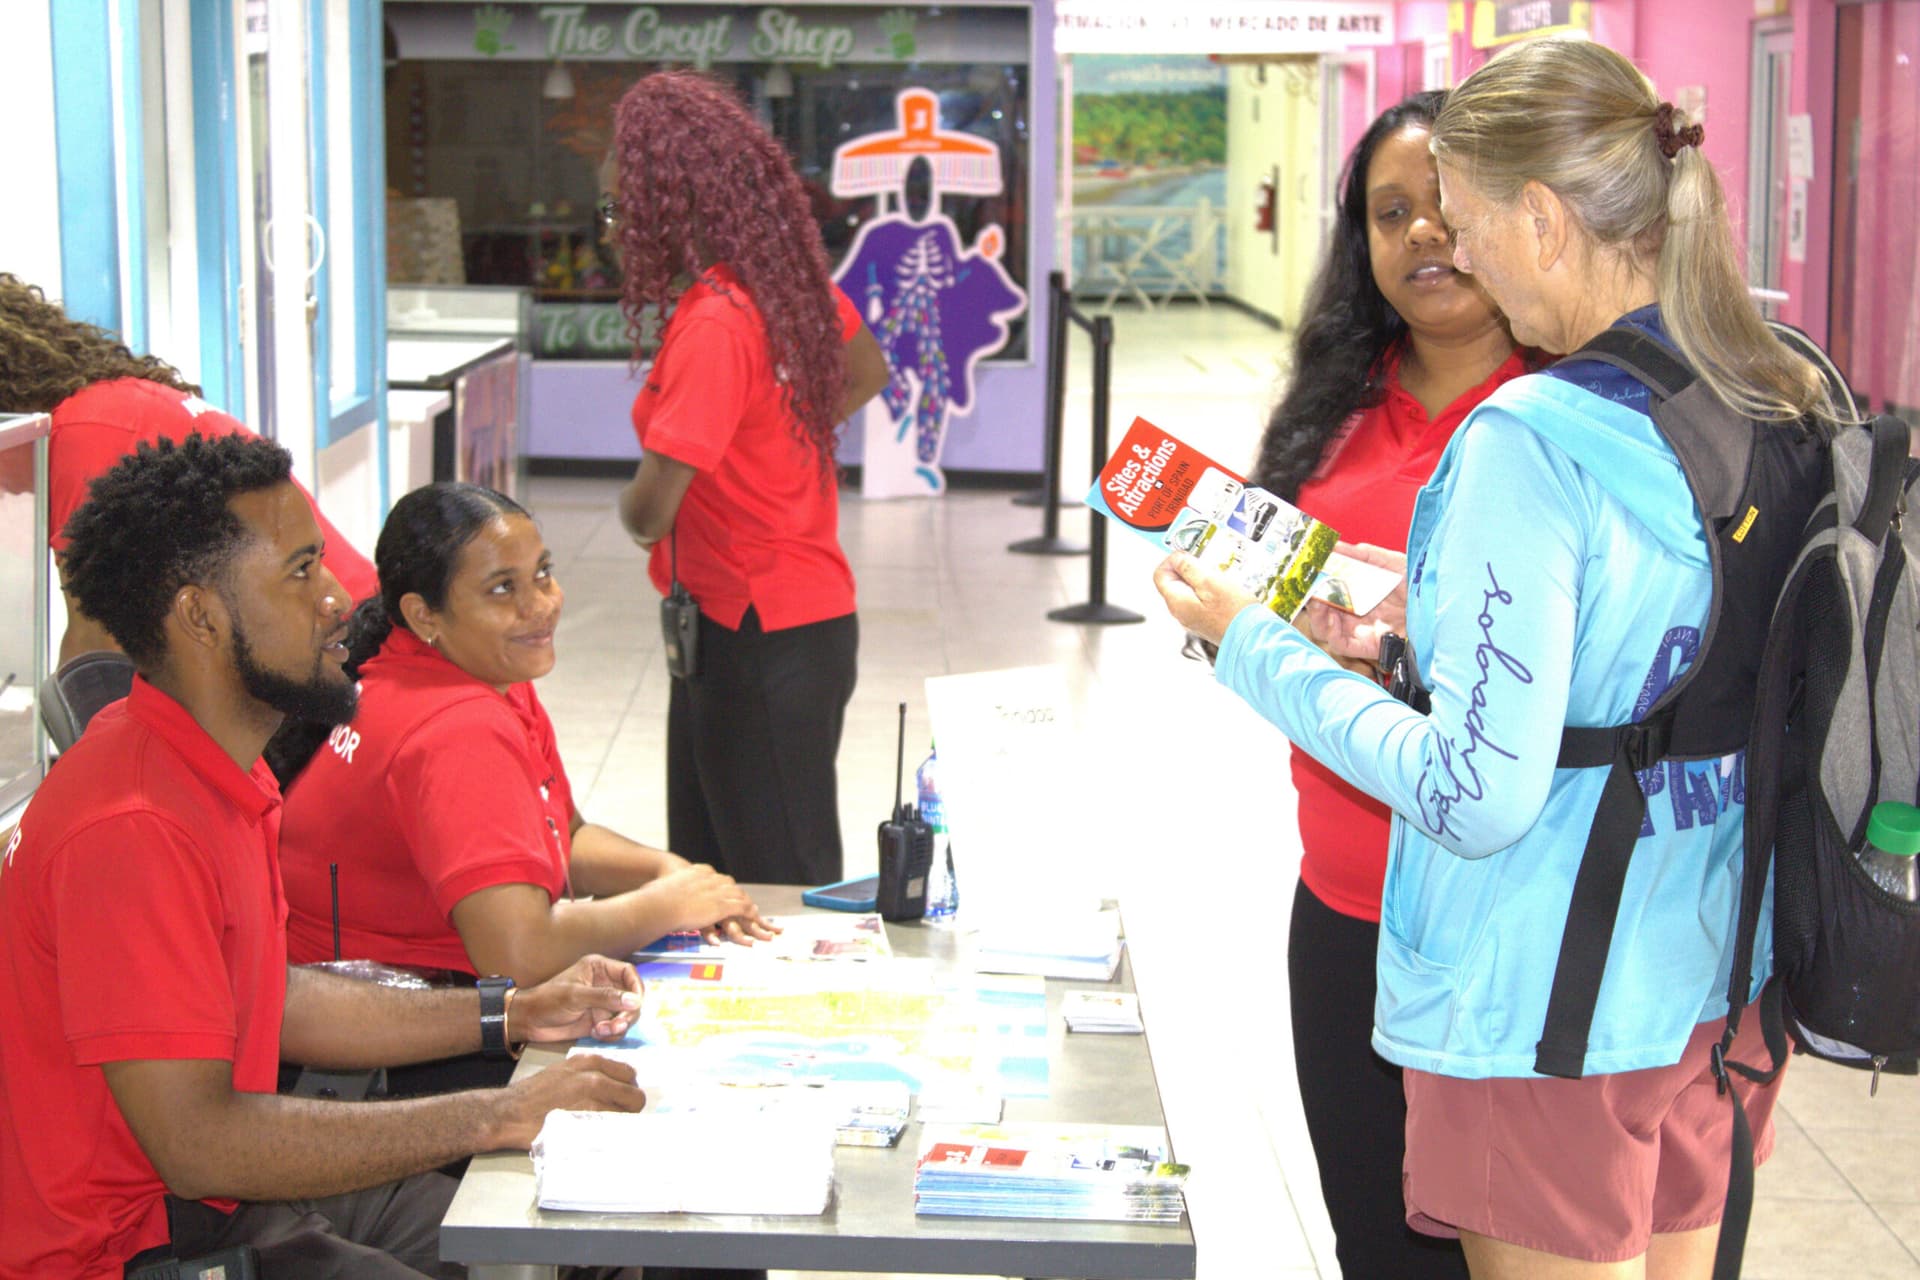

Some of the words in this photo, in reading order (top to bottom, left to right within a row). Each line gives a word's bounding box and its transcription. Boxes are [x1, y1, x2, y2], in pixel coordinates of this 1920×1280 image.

[541, 5, 611, 54] The
[624, 7, 733, 70] Craft
[753, 7, 853, 68] Shop
[1308, 15, 1328, 31] DE
[1337, 15, 1383, 33] ARTE
[540, 308, 578, 351] To
[1106, 459, 1142, 496] Sites
[1131, 444, 1152, 460] &
[1116, 439, 1177, 518] Attractions
[1147, 497, 1166, 519] PORT
[1162, 484, 1174, 499] OF
[1169, 460, 1190, 486] SPAIN
[1165, 477, 1194, 514] TRINIDAD
[328, 723, 361, 764] OR
[4, 823, 22, 869] R
